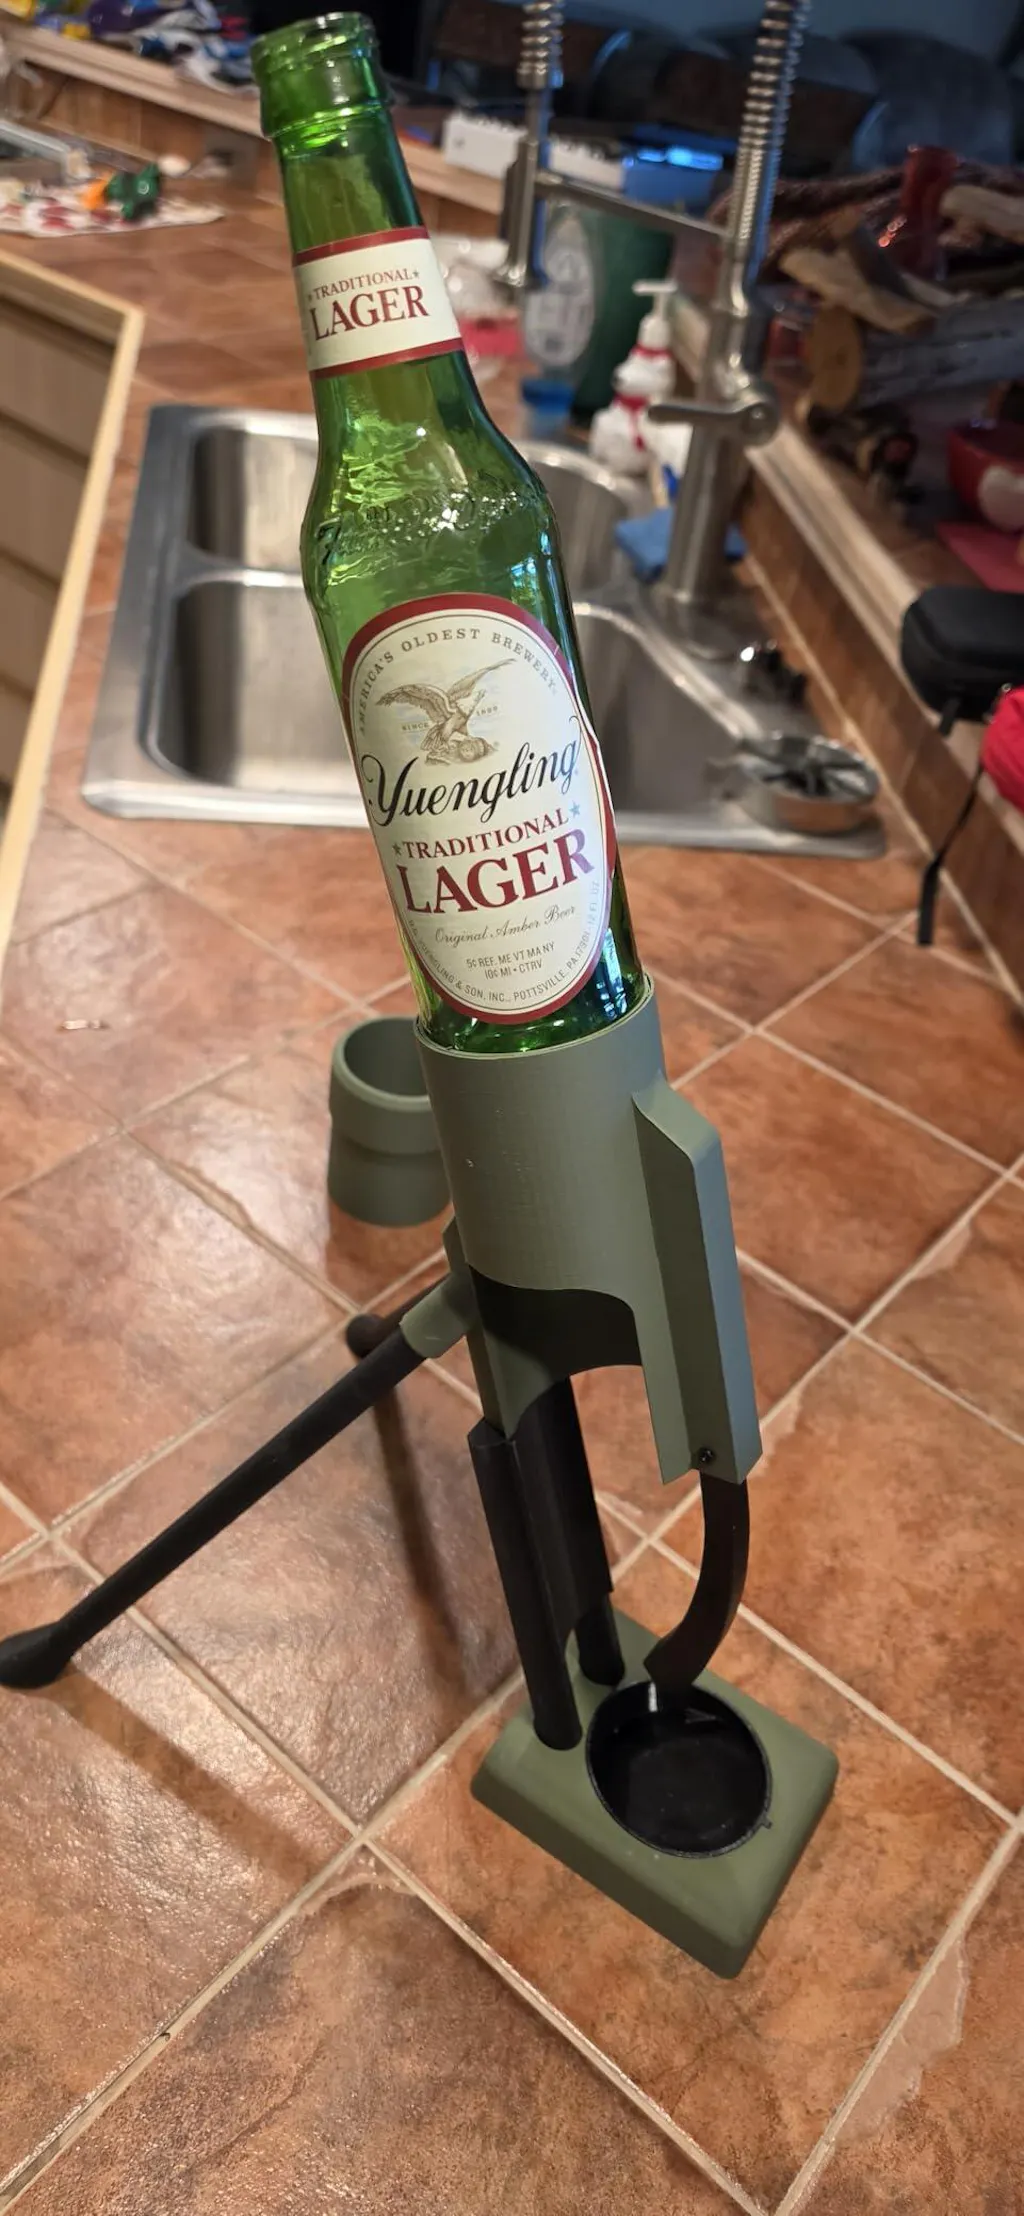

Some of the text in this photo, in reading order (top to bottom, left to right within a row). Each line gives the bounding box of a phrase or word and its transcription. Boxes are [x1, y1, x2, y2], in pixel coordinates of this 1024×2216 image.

[313, 268, 413, 300] TRADITIONAL
[309, 285, 430, 341] LAGER
[400, 628, 481, 652] OLDEST
[361, 715, 582, 827] Yuengling
[401, 807, 568, 860] TRADITIONAL
[396, 828, 595, 914] LAGER
[435, 904, 576, 948] Original Amber Beer
[497, 953, 512, 965] ME
[512, 949, 525, 961] VT
[526, 946, 542, 959] MA
[542, 941, 555, 953] NY
[500, 966, 512, 978] MI
[455, 980, 464, 989] &
[566, 957, 578, 969] PA
